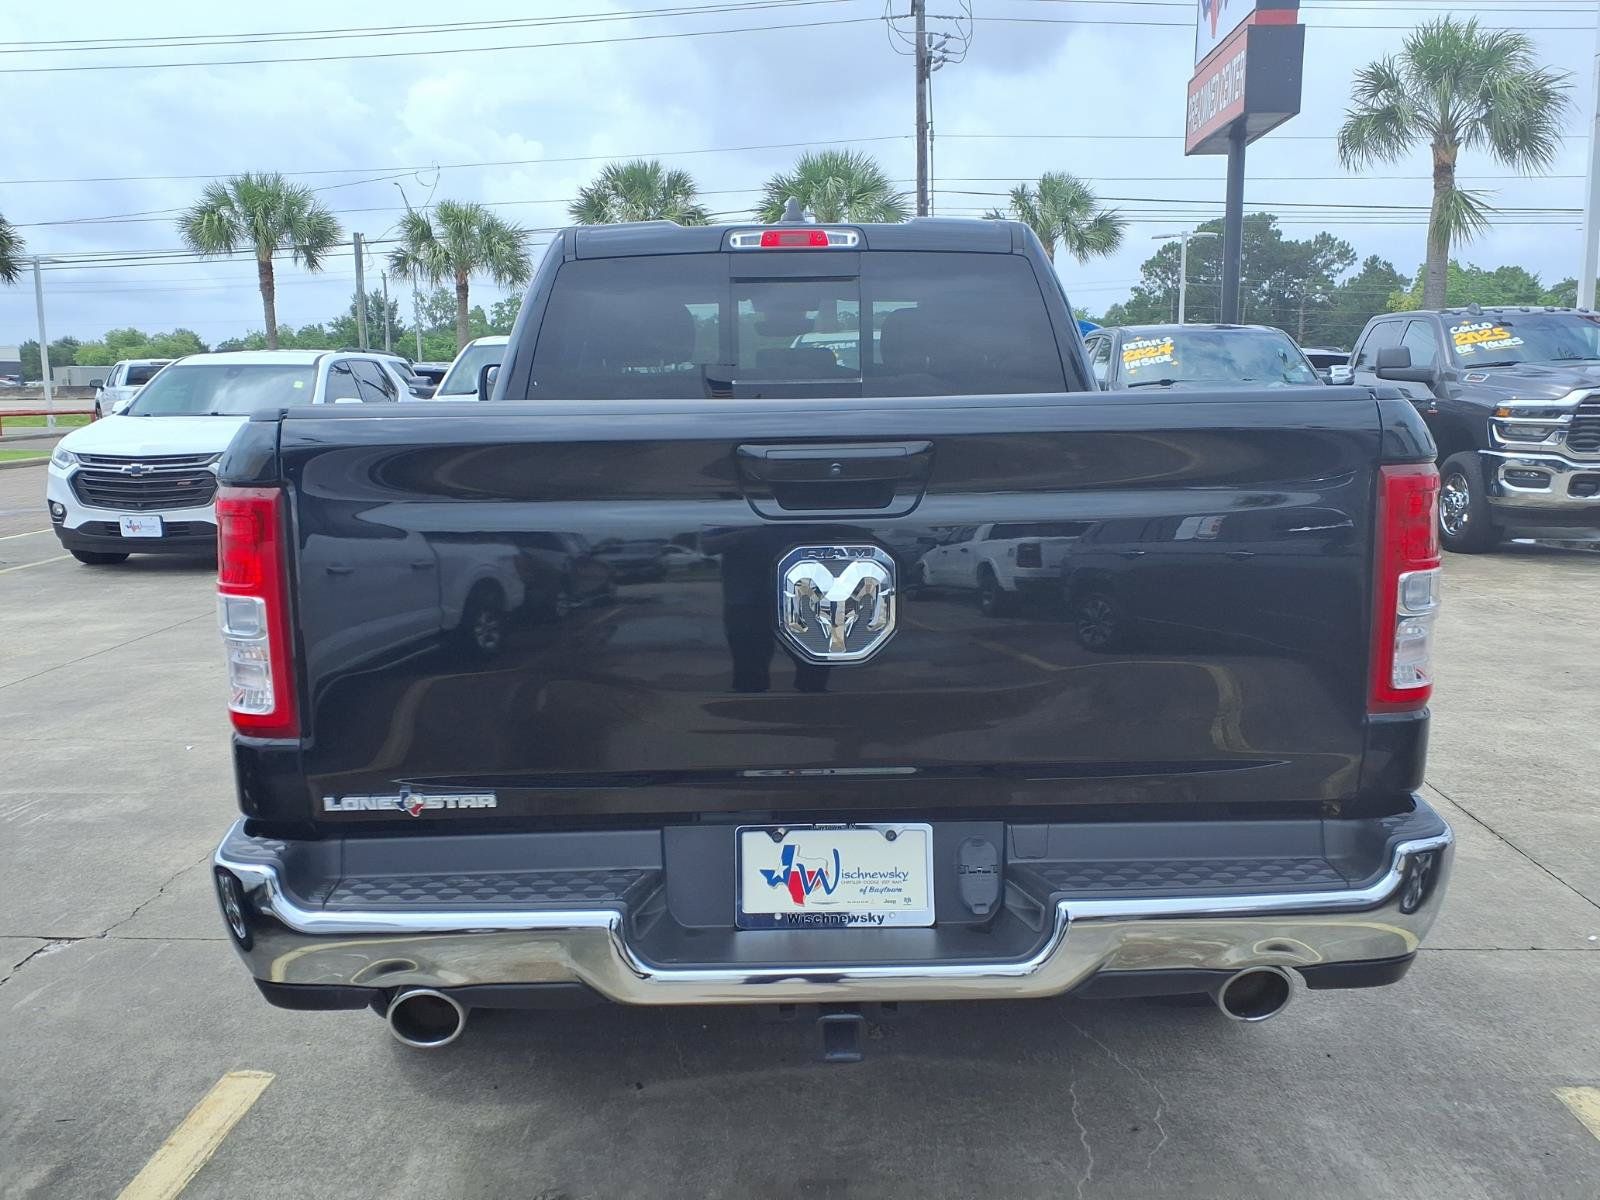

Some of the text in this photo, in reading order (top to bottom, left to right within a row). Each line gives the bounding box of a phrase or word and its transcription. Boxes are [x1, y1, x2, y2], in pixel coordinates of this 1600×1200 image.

[1450, 322, 1493, 334] COULD
[1453, 327, 1511, 345] 2025
[1456, 337, 1524, 354] BE YOURS
[801, 547, 873, 559] RAM
[323, 793, 498, 811] LONE STAR
[859, 885, 903, 895] of Baytown
[787, 912, 884, 925] Wischnewsky
